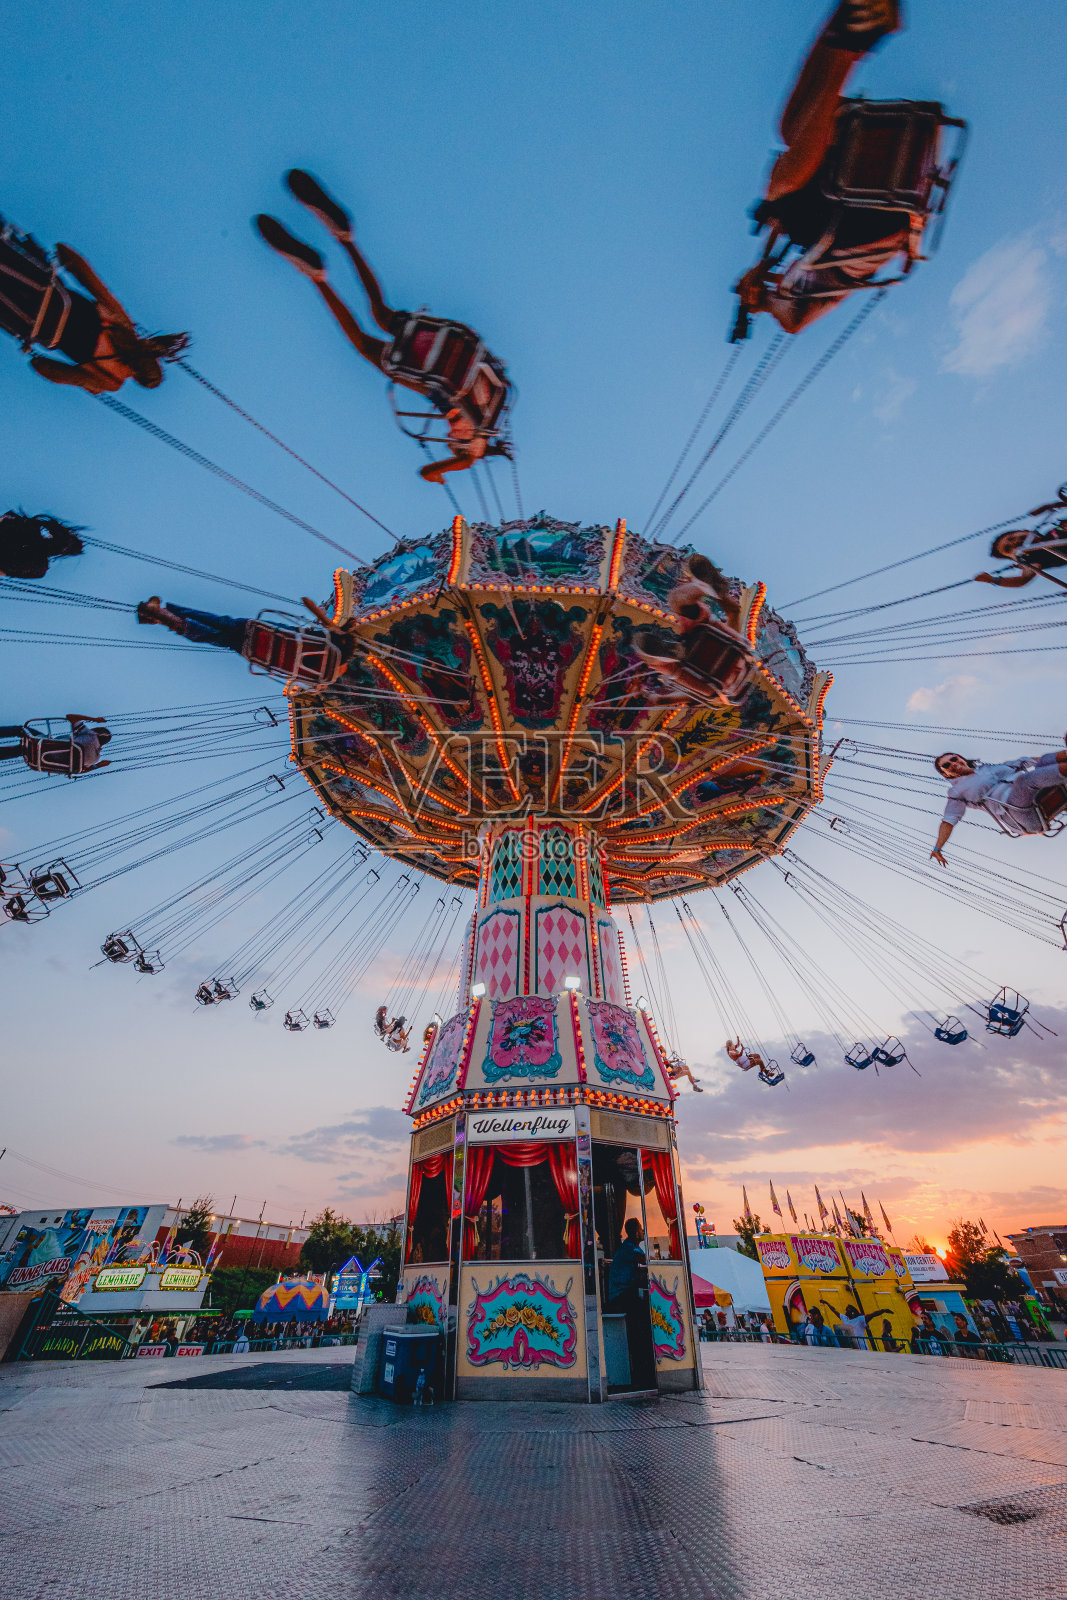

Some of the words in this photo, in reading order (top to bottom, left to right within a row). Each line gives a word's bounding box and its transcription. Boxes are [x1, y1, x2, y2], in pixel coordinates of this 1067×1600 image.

[473, 1116, 571, 1136] Wellenflug
[758, 1240, 789, 1256] TICKETS
[790, 1236, 842, 1266] TICKETS
[843, 1241, 892, 1269] TICKETS
[7, 1264, 42, 1284] FUNNEL
[43, 1257, 72, 1275] CAKES
[97, 1274, 141, 1286] LEMONADE
[164, 1275, 199, 1285] LEMONADE
[138, 1347, 164, 1356] EXIT
[177, 1347, 202, 1356] EXIT
